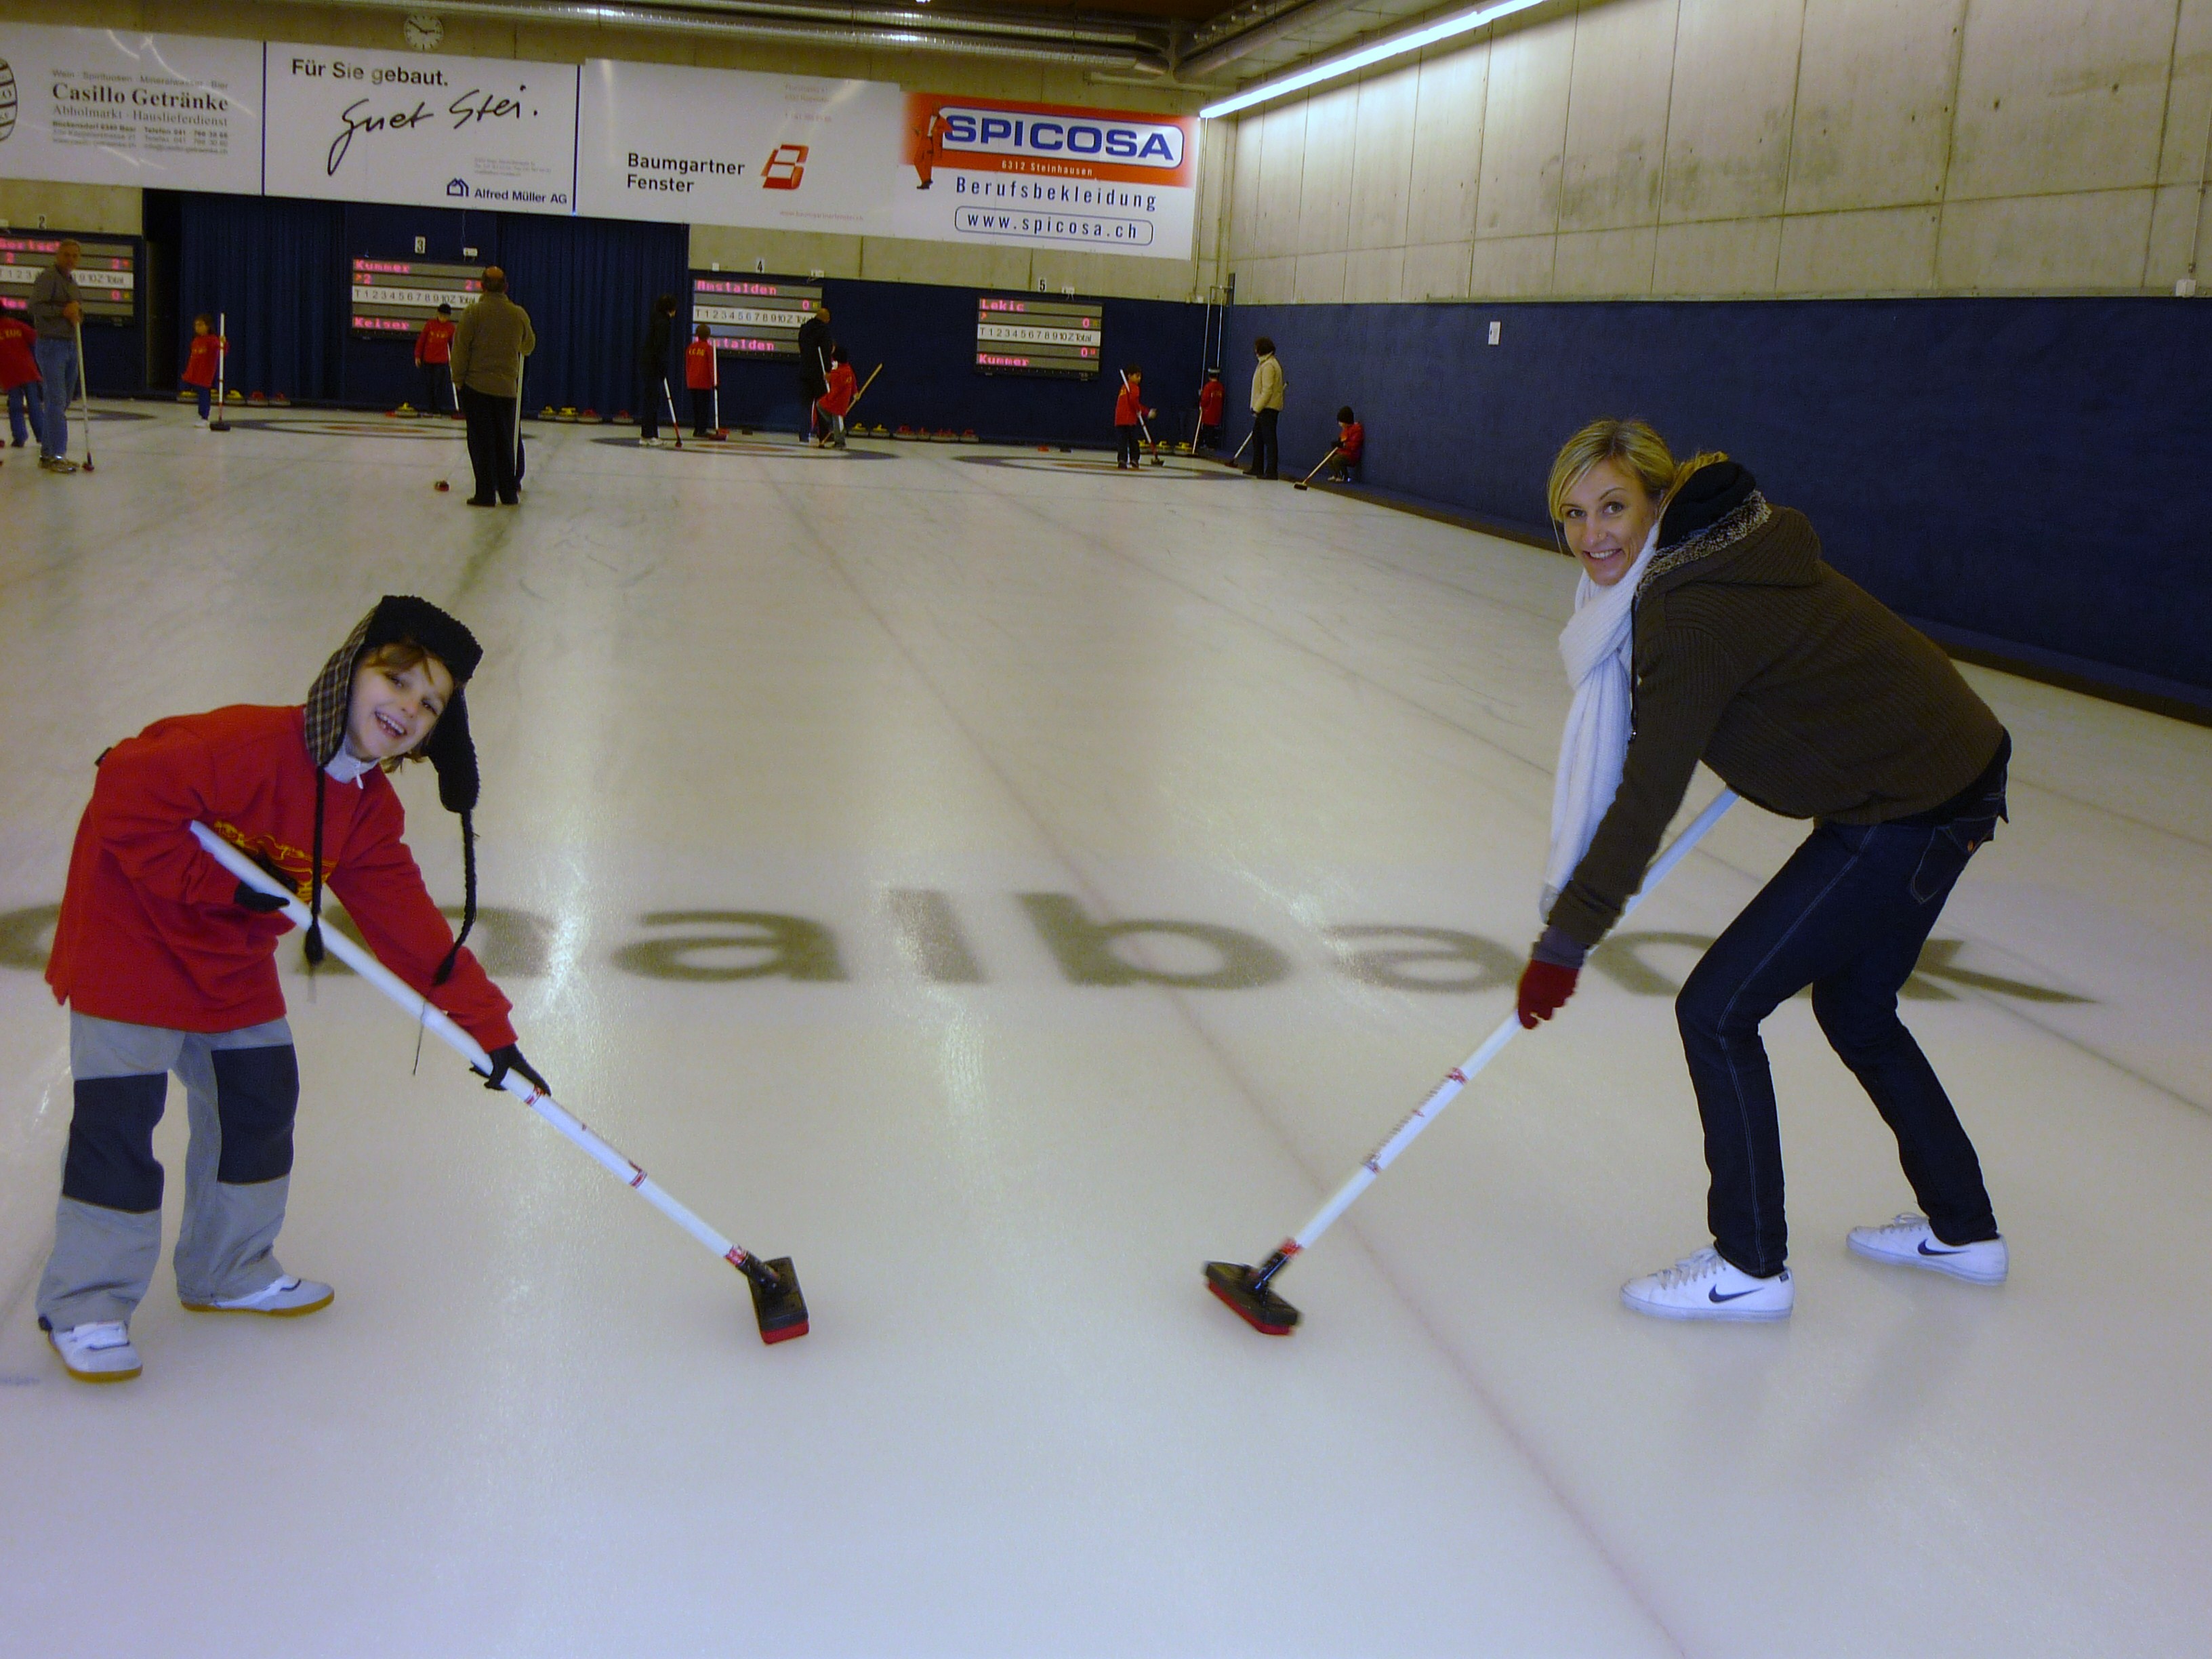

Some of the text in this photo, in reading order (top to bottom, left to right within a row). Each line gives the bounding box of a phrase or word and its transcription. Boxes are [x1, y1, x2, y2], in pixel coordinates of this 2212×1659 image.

[292, 59, 448, 86] Für Sie gebaut.
[53, 82, 229, 111] Casillo Getränke
[945, 113, 1174, 161] SPICOSA
[628, 152, 745, 176] Baumgartner
[1002, 160, 1093, 177] 6312 Steinhausen
[627, 173, 695, 193] Fenster
[474, 188, 568, 204] Alfred Müller AG
[956, 176, 1157, 212] Berufsbekleidung
[968, 212, 1137, 239] www.spicosa.ch
[417, 239, 424, 253] 3
[758, 260, 763, 272] 4
[363, 273, 472, 291] 2 2
[1039, 279, 1046, 291] 5
[996, 329, 1002, 337] 2
[1004, 329, 1010, 337] 3
[1029, 331, 1033, 339] 6
[1067, 333, 1074, 341] Z
[1076, 333, 1092, 342] Total
